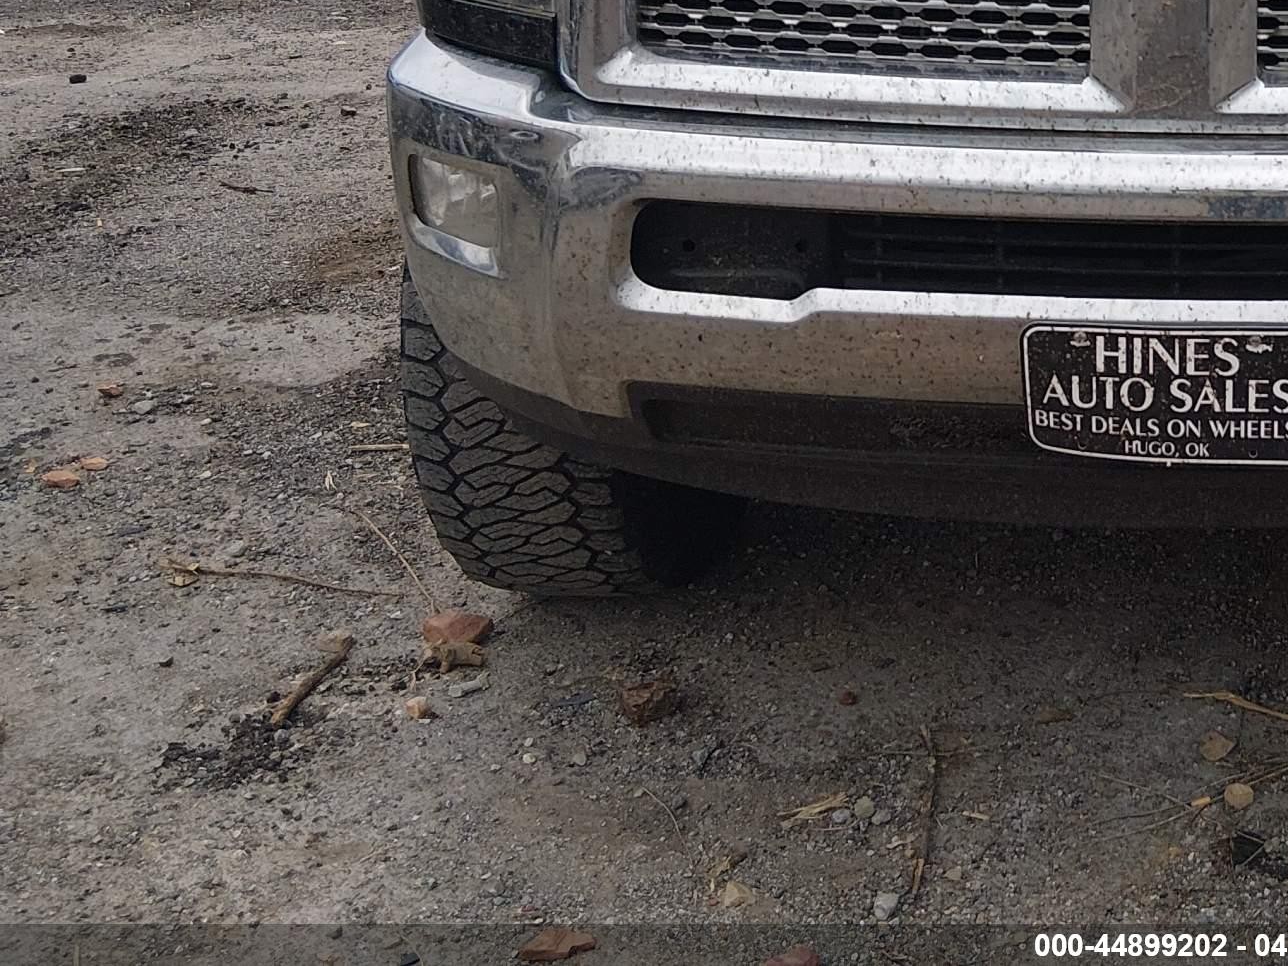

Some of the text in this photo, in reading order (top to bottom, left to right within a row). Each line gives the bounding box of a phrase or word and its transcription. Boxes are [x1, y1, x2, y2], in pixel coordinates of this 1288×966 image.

[1095, 335, 1240, 377] HINES
[1042, 374, 1155, 412] AUTO
[1034, 409, 1084, 432] BEST
[1091, 415, 1161, 437] DEALS
[1166, 418, 1201, 438] ON
[1124, 439, 1210, 458] HUGO, OK
